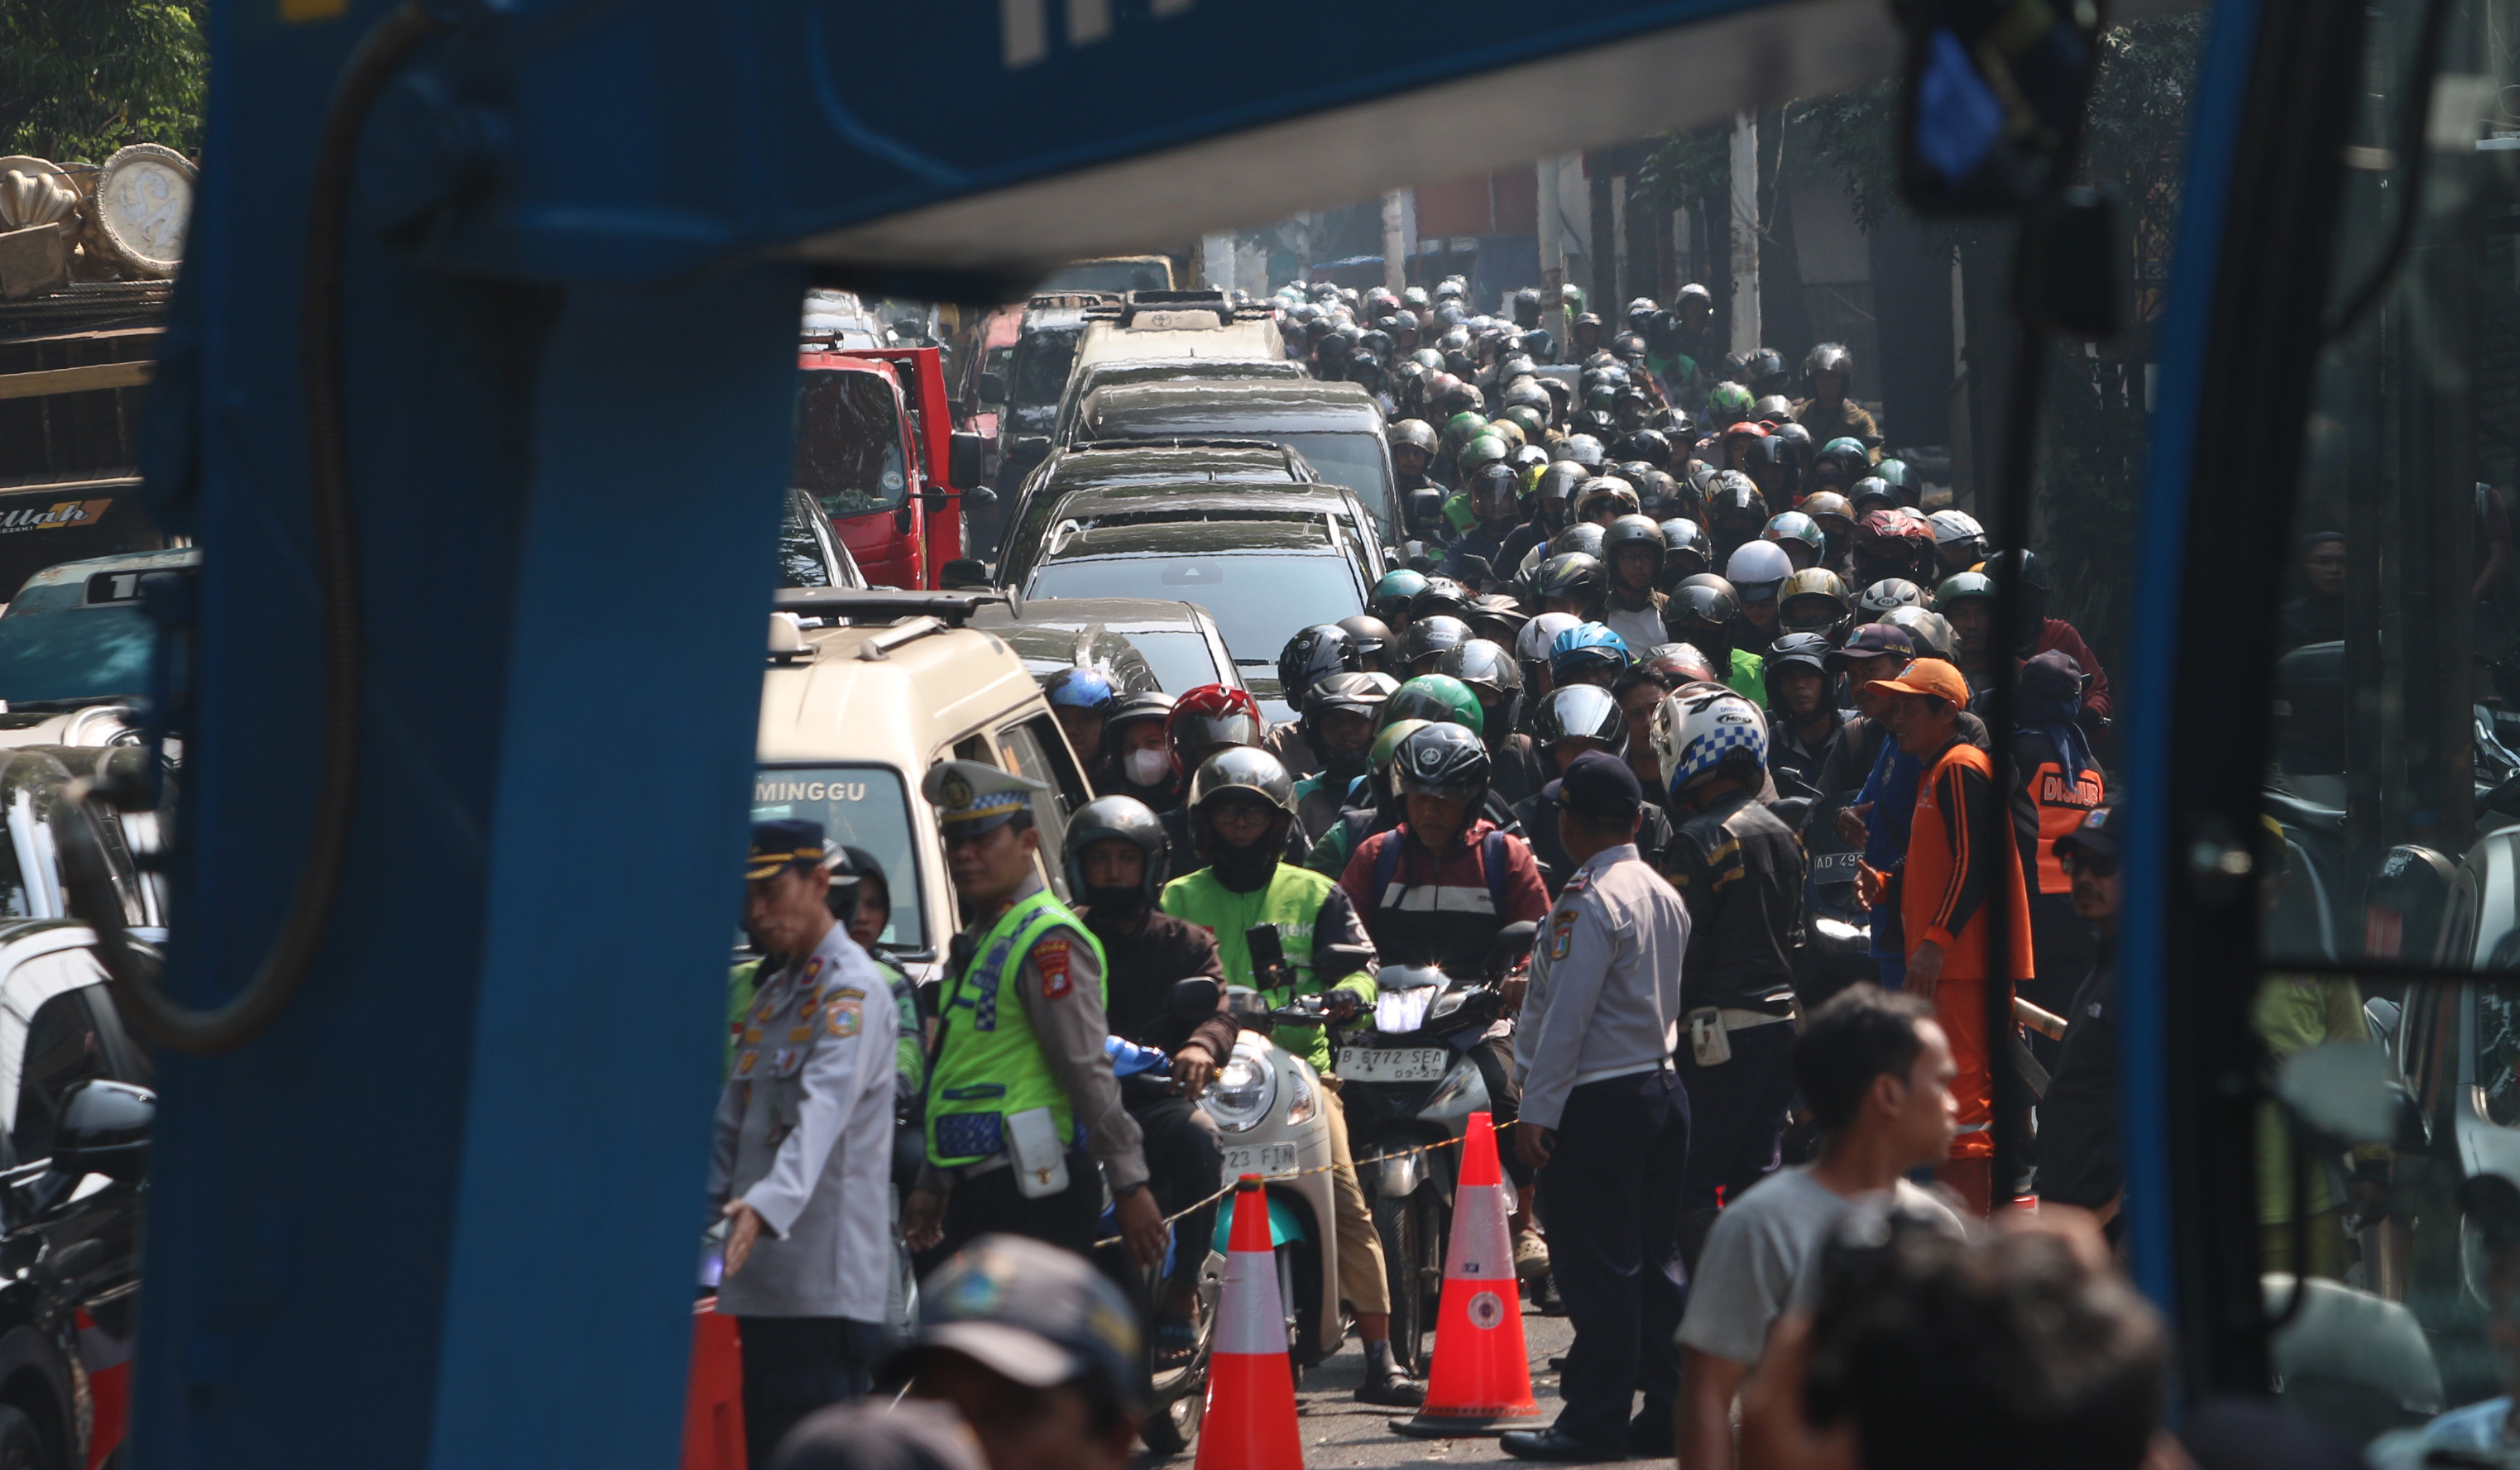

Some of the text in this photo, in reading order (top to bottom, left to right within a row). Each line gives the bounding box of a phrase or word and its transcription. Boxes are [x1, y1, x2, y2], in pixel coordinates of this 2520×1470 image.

[0, 504, 89, 527] llah
[755, 782, 865, 802] MINGGU
[1817, 856, 1833, 869] AD
[1343, 1050, 1353, 1063] B
[1362, 1051, 1402, 1065] 6772
[1229, 1151, 1250, 1168] 23
